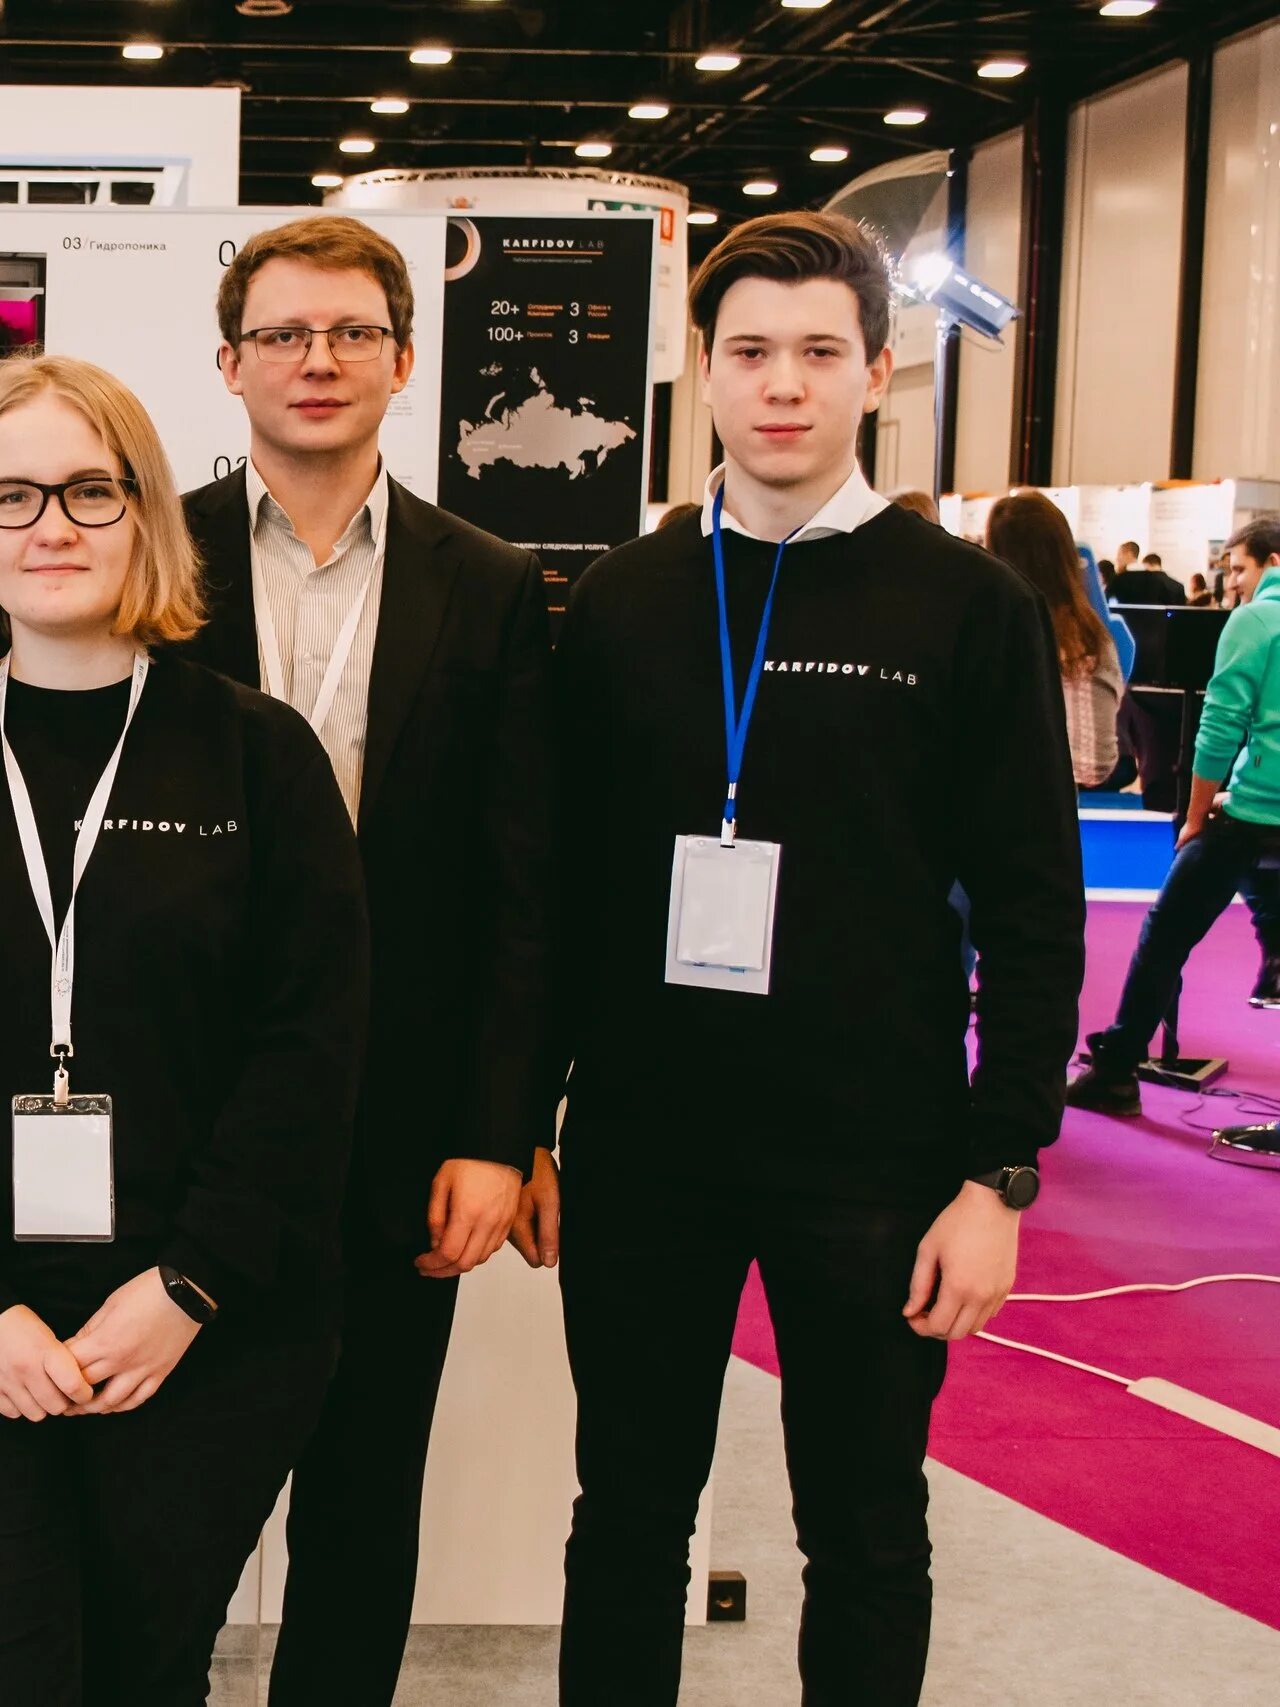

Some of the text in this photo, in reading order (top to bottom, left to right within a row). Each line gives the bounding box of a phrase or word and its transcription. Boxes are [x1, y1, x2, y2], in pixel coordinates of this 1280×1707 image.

[502, 239, 604, 249] KARFIDOV LAB
[219, 240, 236, 266] 0
[491, 300, 520, 315] 20+
[569, 302, 580, 316] 3
[487, 327, 524, 341] 100+
[568, 330, 578, 344] 3
[763, 661, 917, 685] KARFIDOV LAB
[74, 819, 238, 836] KRFIDOV LAB
